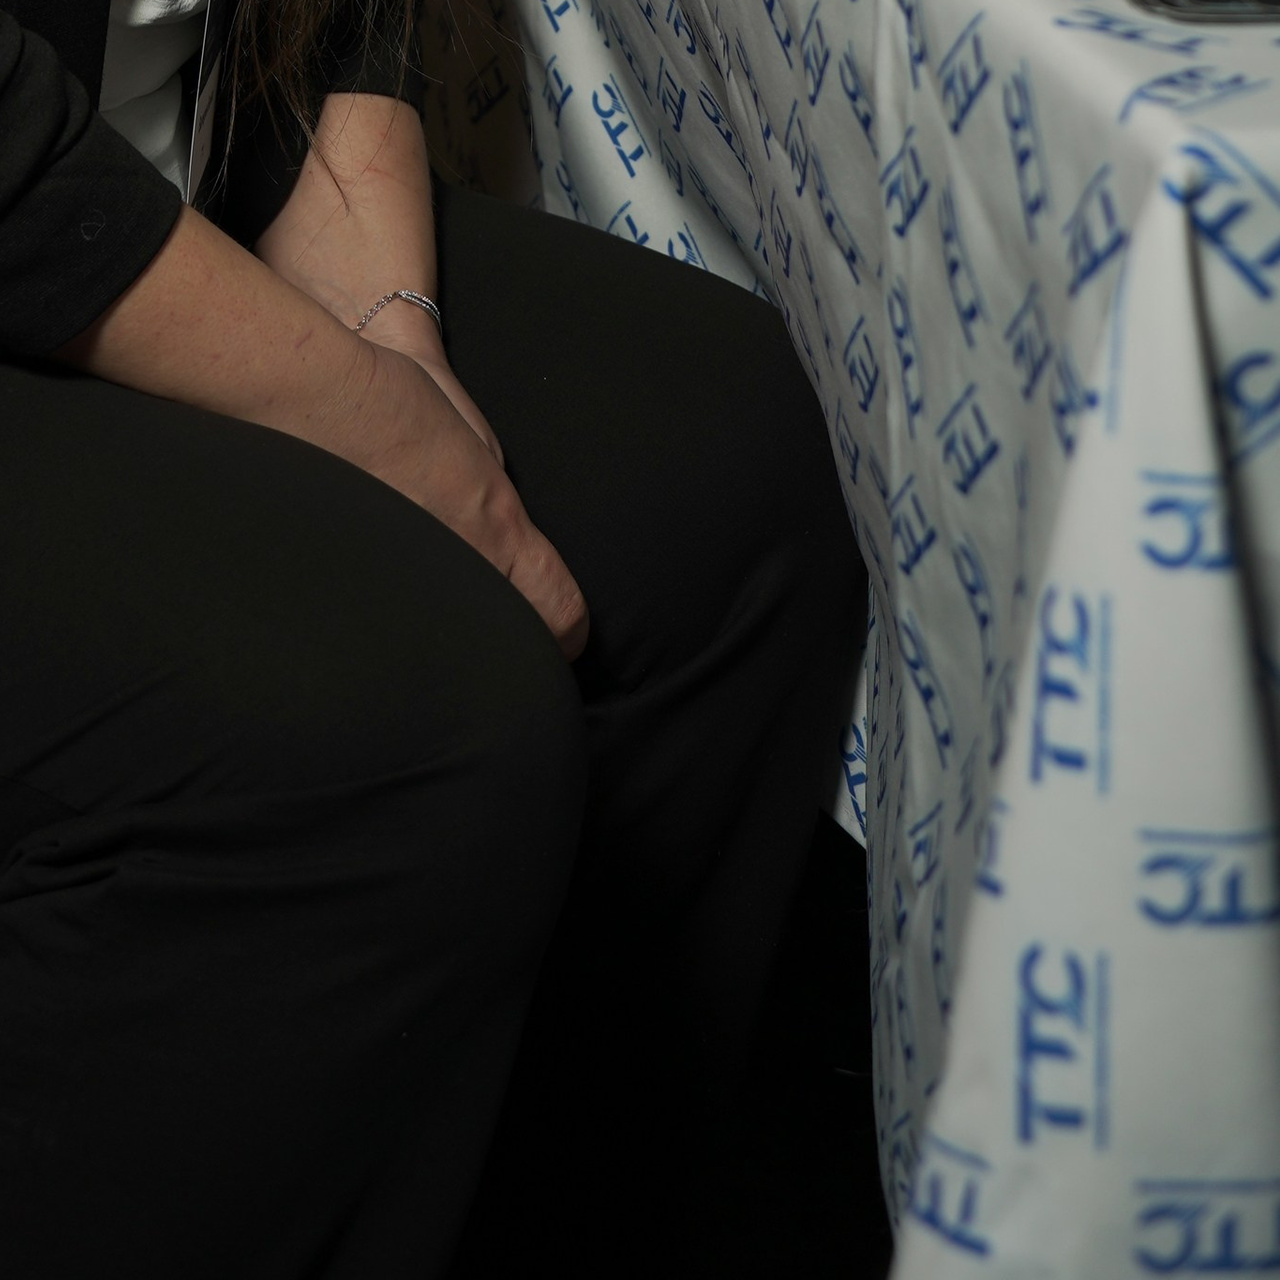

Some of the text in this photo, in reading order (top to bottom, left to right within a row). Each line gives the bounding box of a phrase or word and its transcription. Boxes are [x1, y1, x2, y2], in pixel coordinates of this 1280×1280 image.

[592, 82, 645, 178] TTC
[1032, 586, 1091, 783] TTC
[1019, 943, 1087, 1144] TTC
